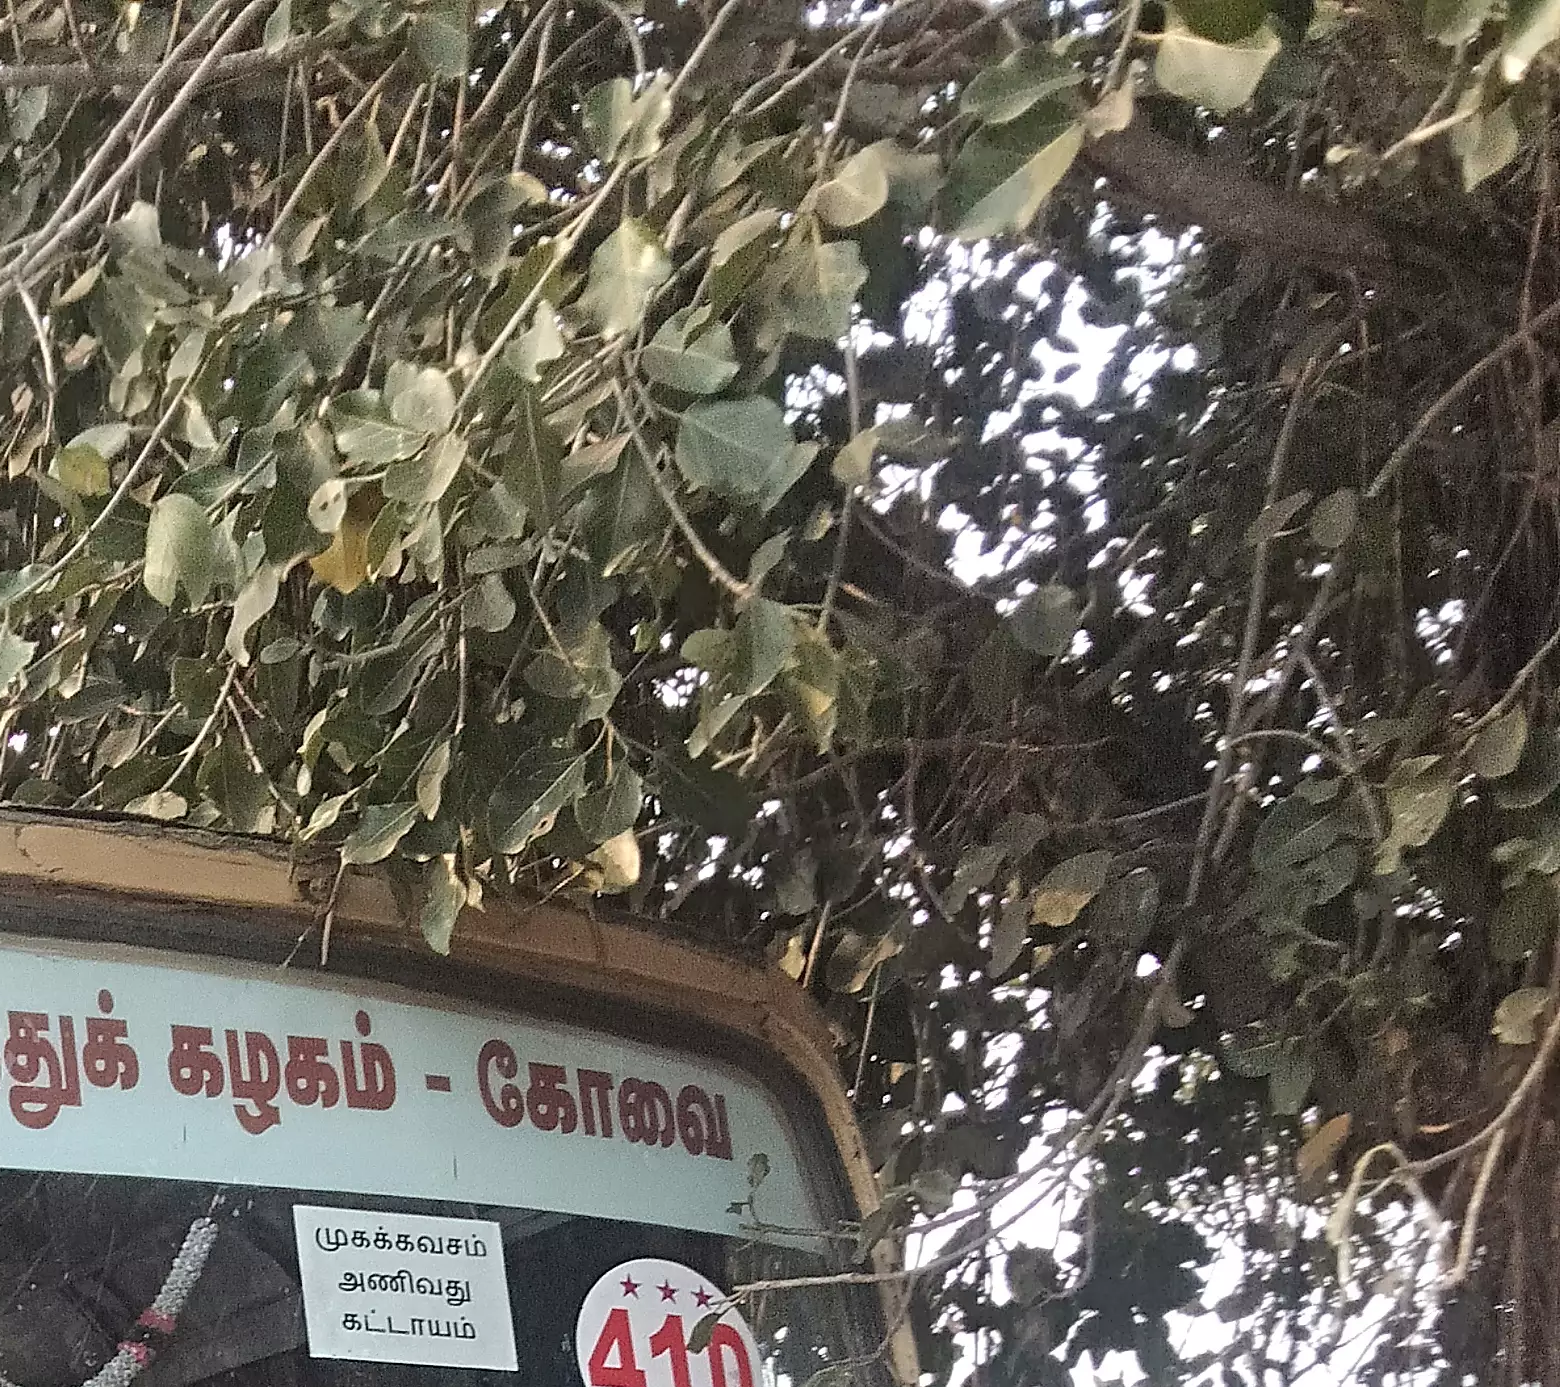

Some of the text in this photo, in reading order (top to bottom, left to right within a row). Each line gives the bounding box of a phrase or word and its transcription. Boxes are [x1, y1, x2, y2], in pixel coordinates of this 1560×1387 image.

[168, 1009, 397, 1136] கழகம்
[425, 1073, 452, 1093] -
[476, 1036, 734, 1161] கோவை
[314, 1225, 487, 1258] முகக்கவசம்
[338, 1269, 472, 1304] அணிவது
[341, 1310, 476, 1340] கட்டாயம்
